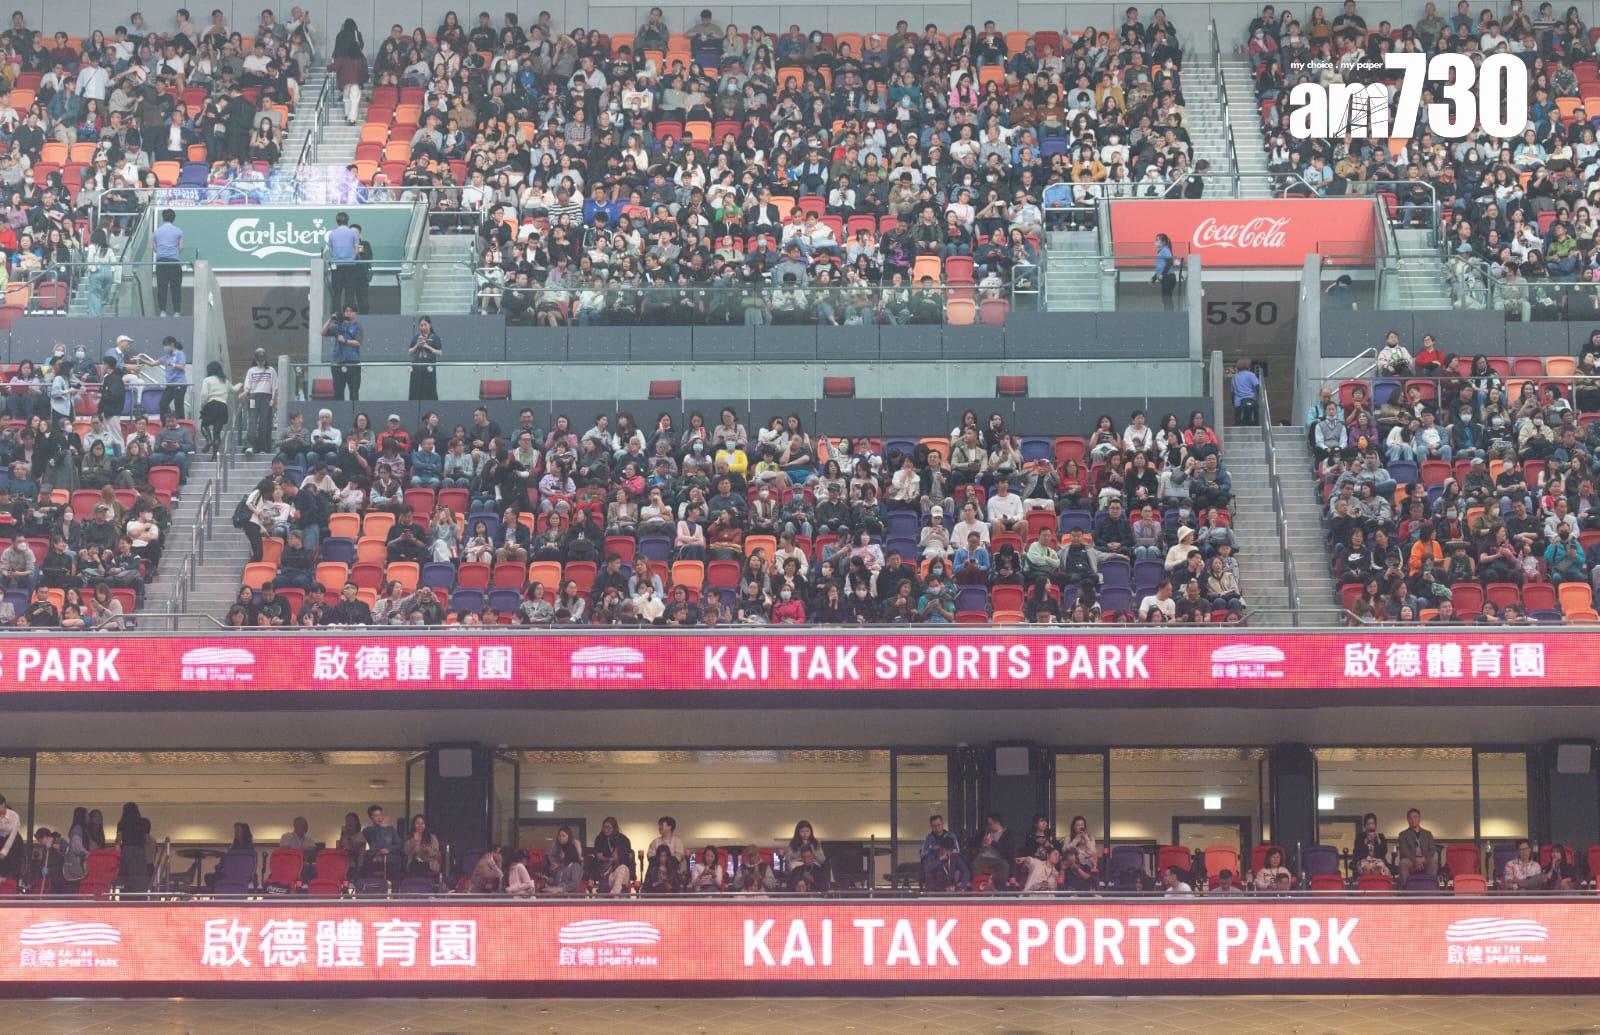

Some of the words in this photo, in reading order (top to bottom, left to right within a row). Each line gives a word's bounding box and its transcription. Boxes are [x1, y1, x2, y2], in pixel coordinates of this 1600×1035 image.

[1192, 216, 1291, 248] Coca-Cola
[1206, 301, 1278, 326] 530
[17, 646, 121, 682] PARK
[313, 645, 513, 680] 啟德體育園
[704, 646, 769, 681] KAI
[784, 645, 860, 680] TAK
[875, 644, 1031, 680] SPORTS
[1046, 644, 1149, 679] PARK
[1344, 642, 1546, 677] 啟德體育園
[201, 918, 477, 968] 啟德體育園
[743, 918, 833, 966] KAI
[853, 918, 959, 966] TAK
[981, 917, 1196, 966] SPORTS
[1217, 917, 1361, 965] PARK
